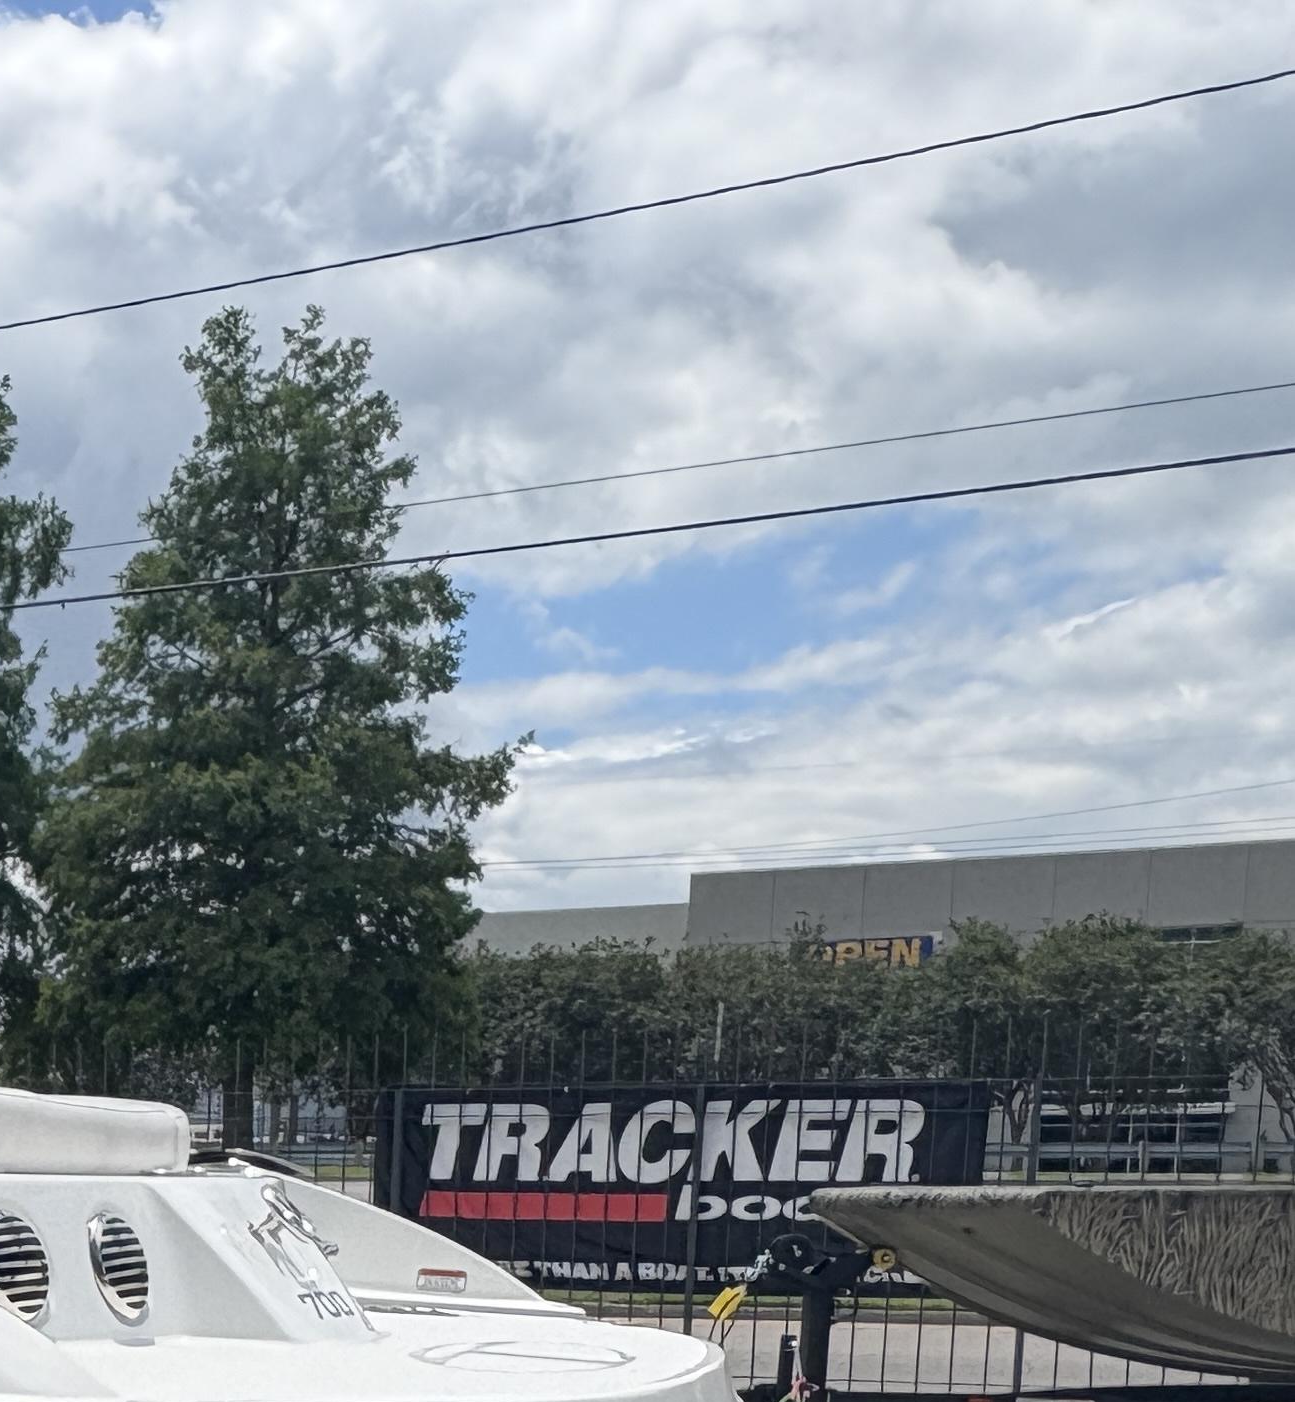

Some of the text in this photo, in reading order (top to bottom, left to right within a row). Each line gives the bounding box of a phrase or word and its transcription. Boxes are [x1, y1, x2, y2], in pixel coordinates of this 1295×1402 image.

[808, 938, 922, 968] PEN
[421, 1099, 924, 1183] TRACKER
[533, 1261, 609, 1281] THAN
[614, 1262, 633, 1280] A
[297, 1291, 355, 1320] 700
